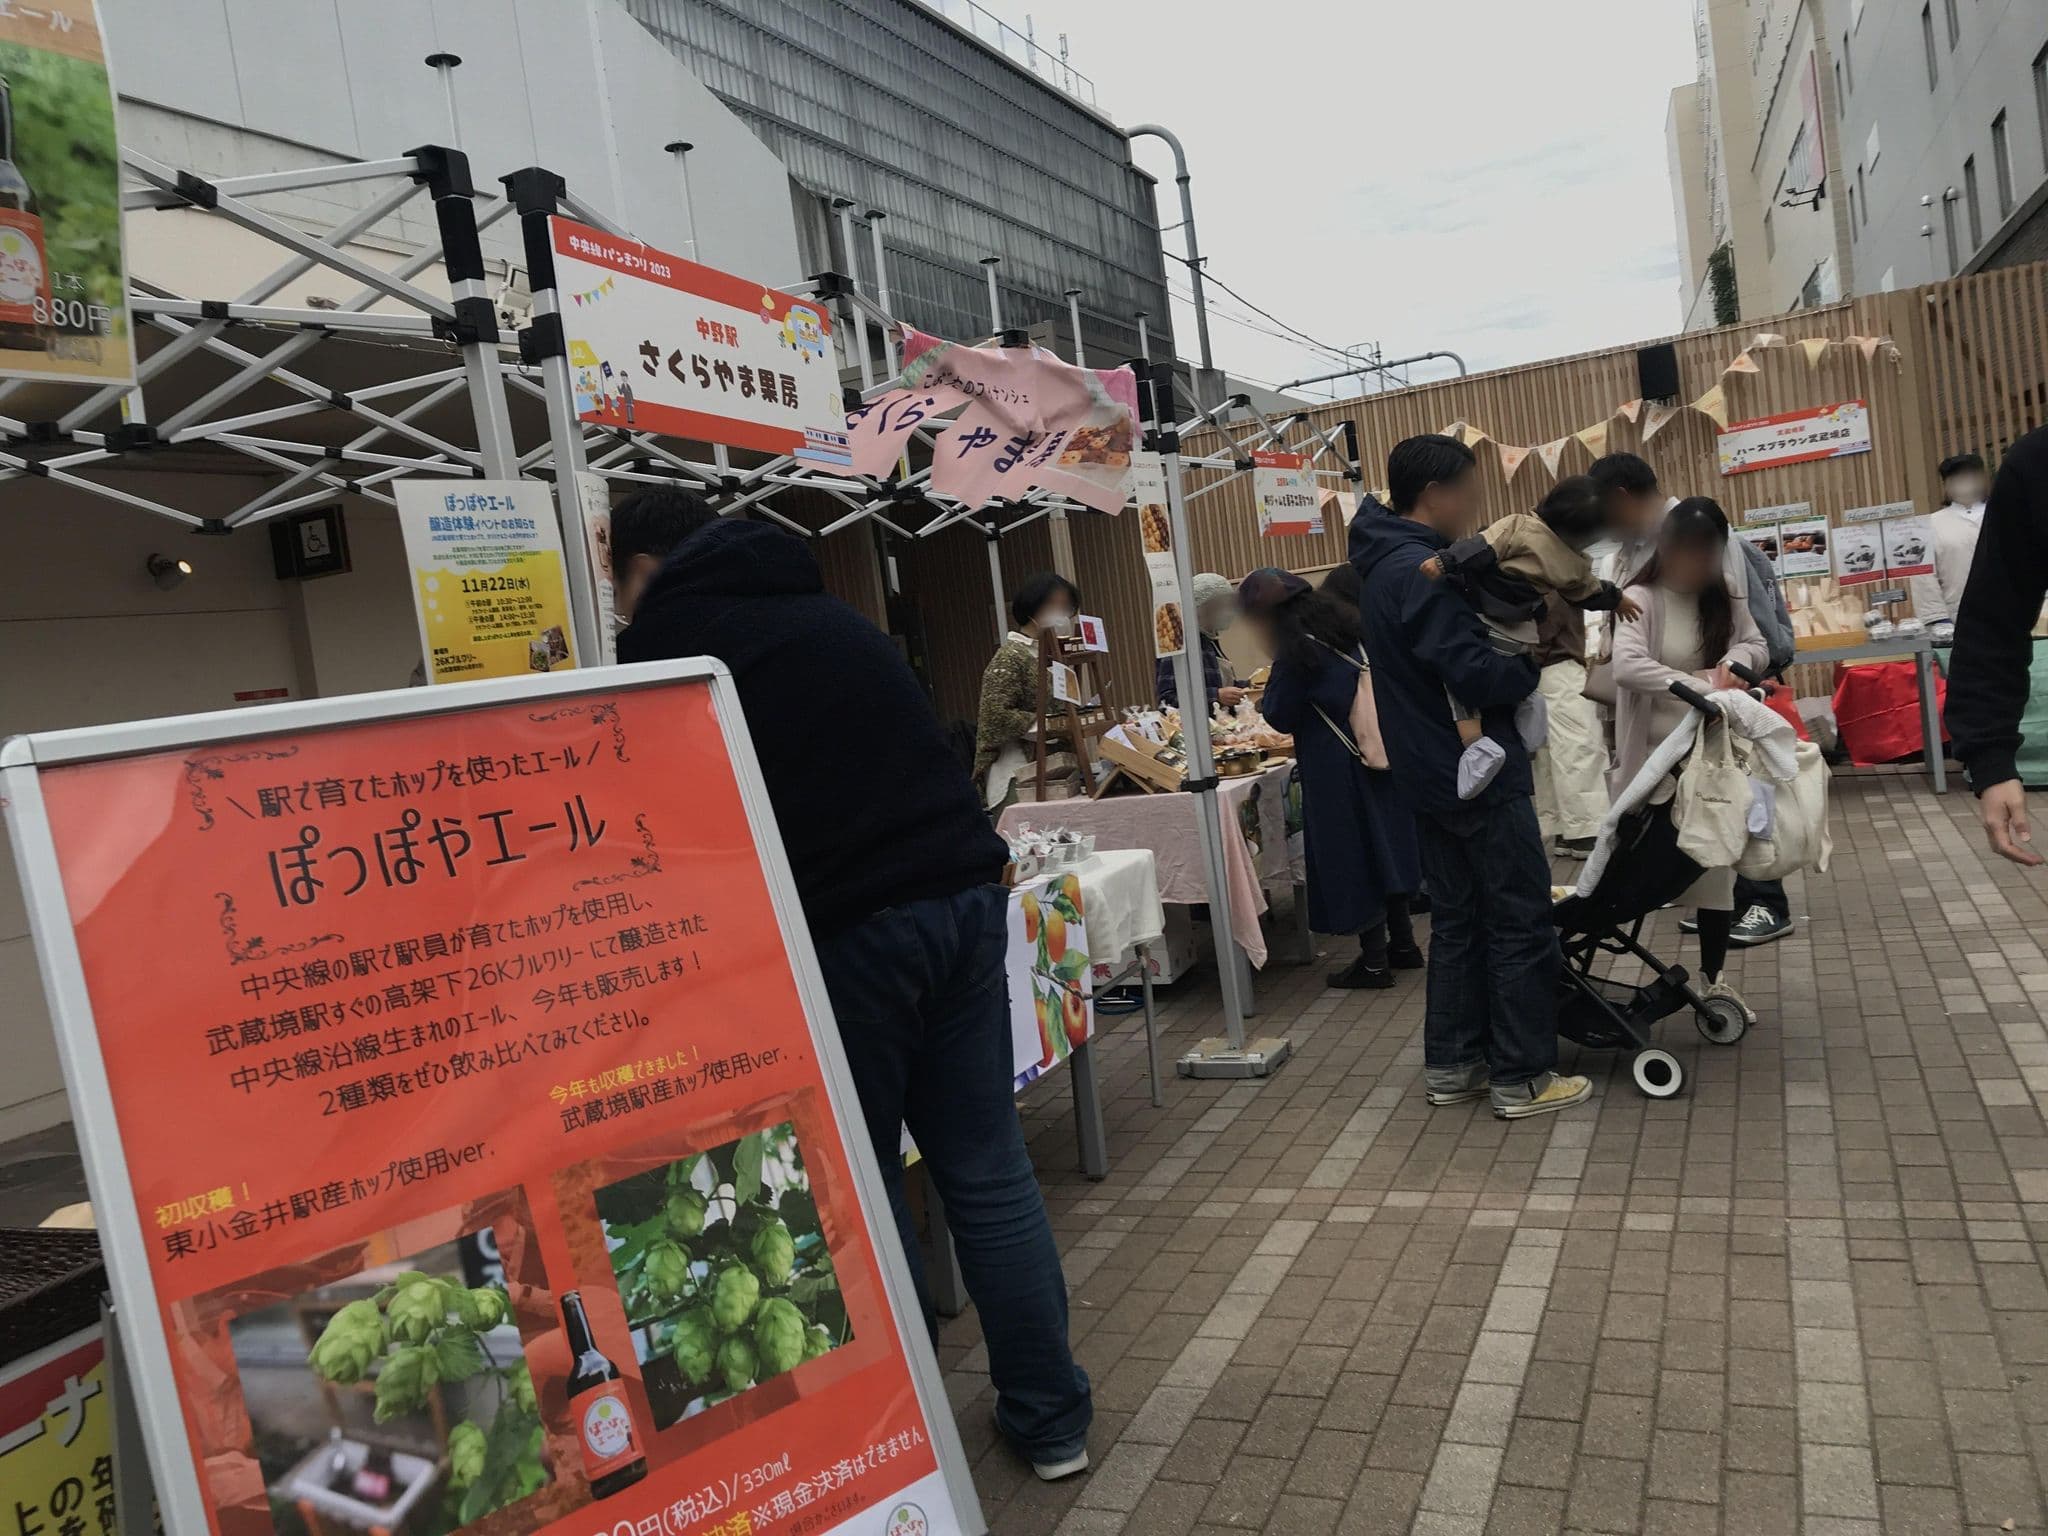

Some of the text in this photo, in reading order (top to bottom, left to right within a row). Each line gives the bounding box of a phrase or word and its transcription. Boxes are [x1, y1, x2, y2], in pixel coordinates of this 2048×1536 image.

[568, 234, 672, 279] 中央線パンまつり 2023
[32, 295, 112, 337] 880円
[695, 316, 741, 349] 中野駅
[638, 339, 799, 410] さくらやま果房
[444, 493, 515, 511] ぽっぽやエール
[461, 576, 530, 593] 11月22日(水)
[267, 794, 606, 908] ぽっぽやエール
[240, 892, 653, 1001] 中央線の駅で駅員が育てたホップを使用し、
[318, 1008, 650, 1116] 2種類をぜひ飲み比べてみてください。
[549, 1045, 700, 1105] 今年も収穫できました！
[155, 1182, 250, 1229] 初収穫！
[162, 1142, 496, 1263] 東小金井駅産ホップ使用ver.
